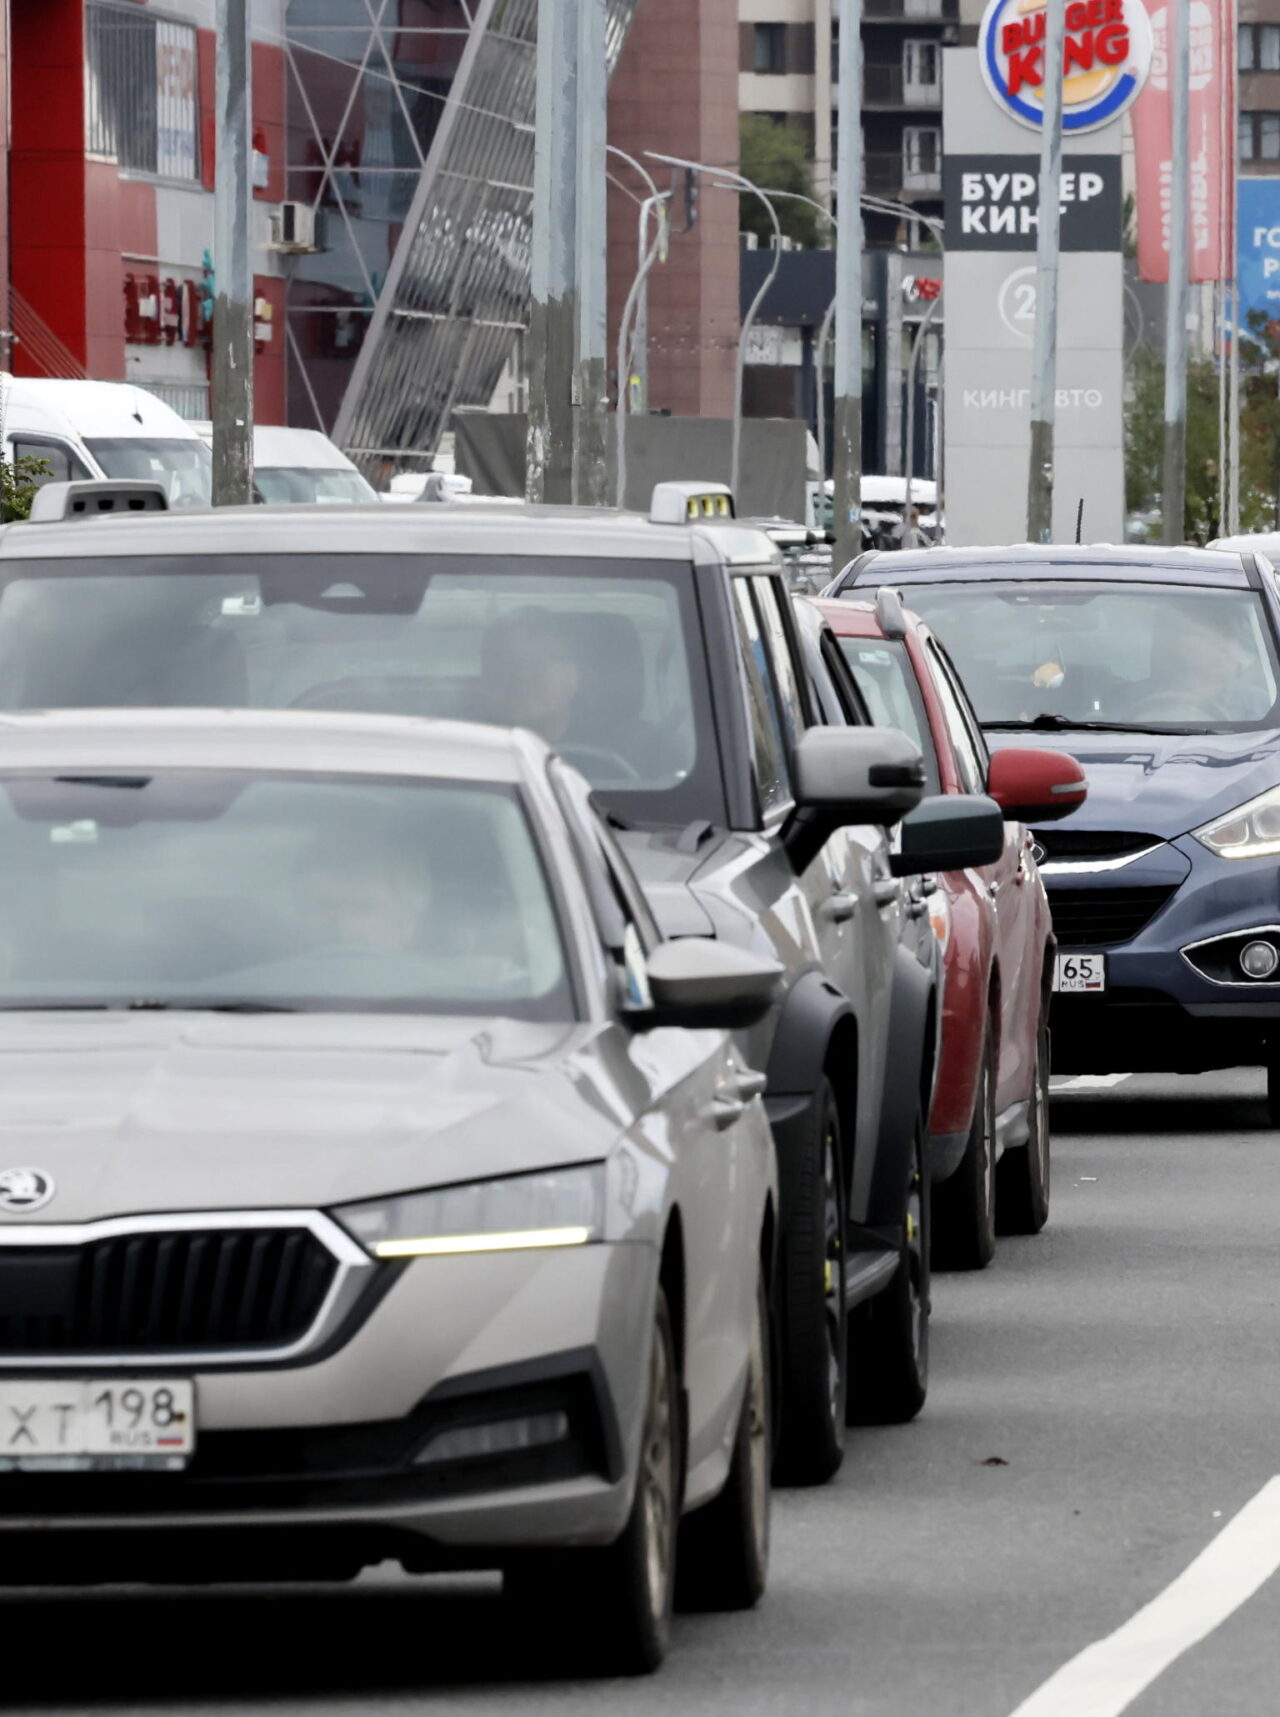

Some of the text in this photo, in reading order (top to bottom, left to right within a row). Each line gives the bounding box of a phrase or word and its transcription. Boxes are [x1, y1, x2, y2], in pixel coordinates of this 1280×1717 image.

[1002, 0, 1124, 54] BUGER
[1008, 23, 1130, 96] KNG
[961, 173, 1104, 202] БУРЕР
[961, 205, 1067, 234] КИН
[963, 388, 1103, 408] КИНГ ВТО
[1063, 958, 1093, 979] 65
[95, 1387, 174, 1428] 198
